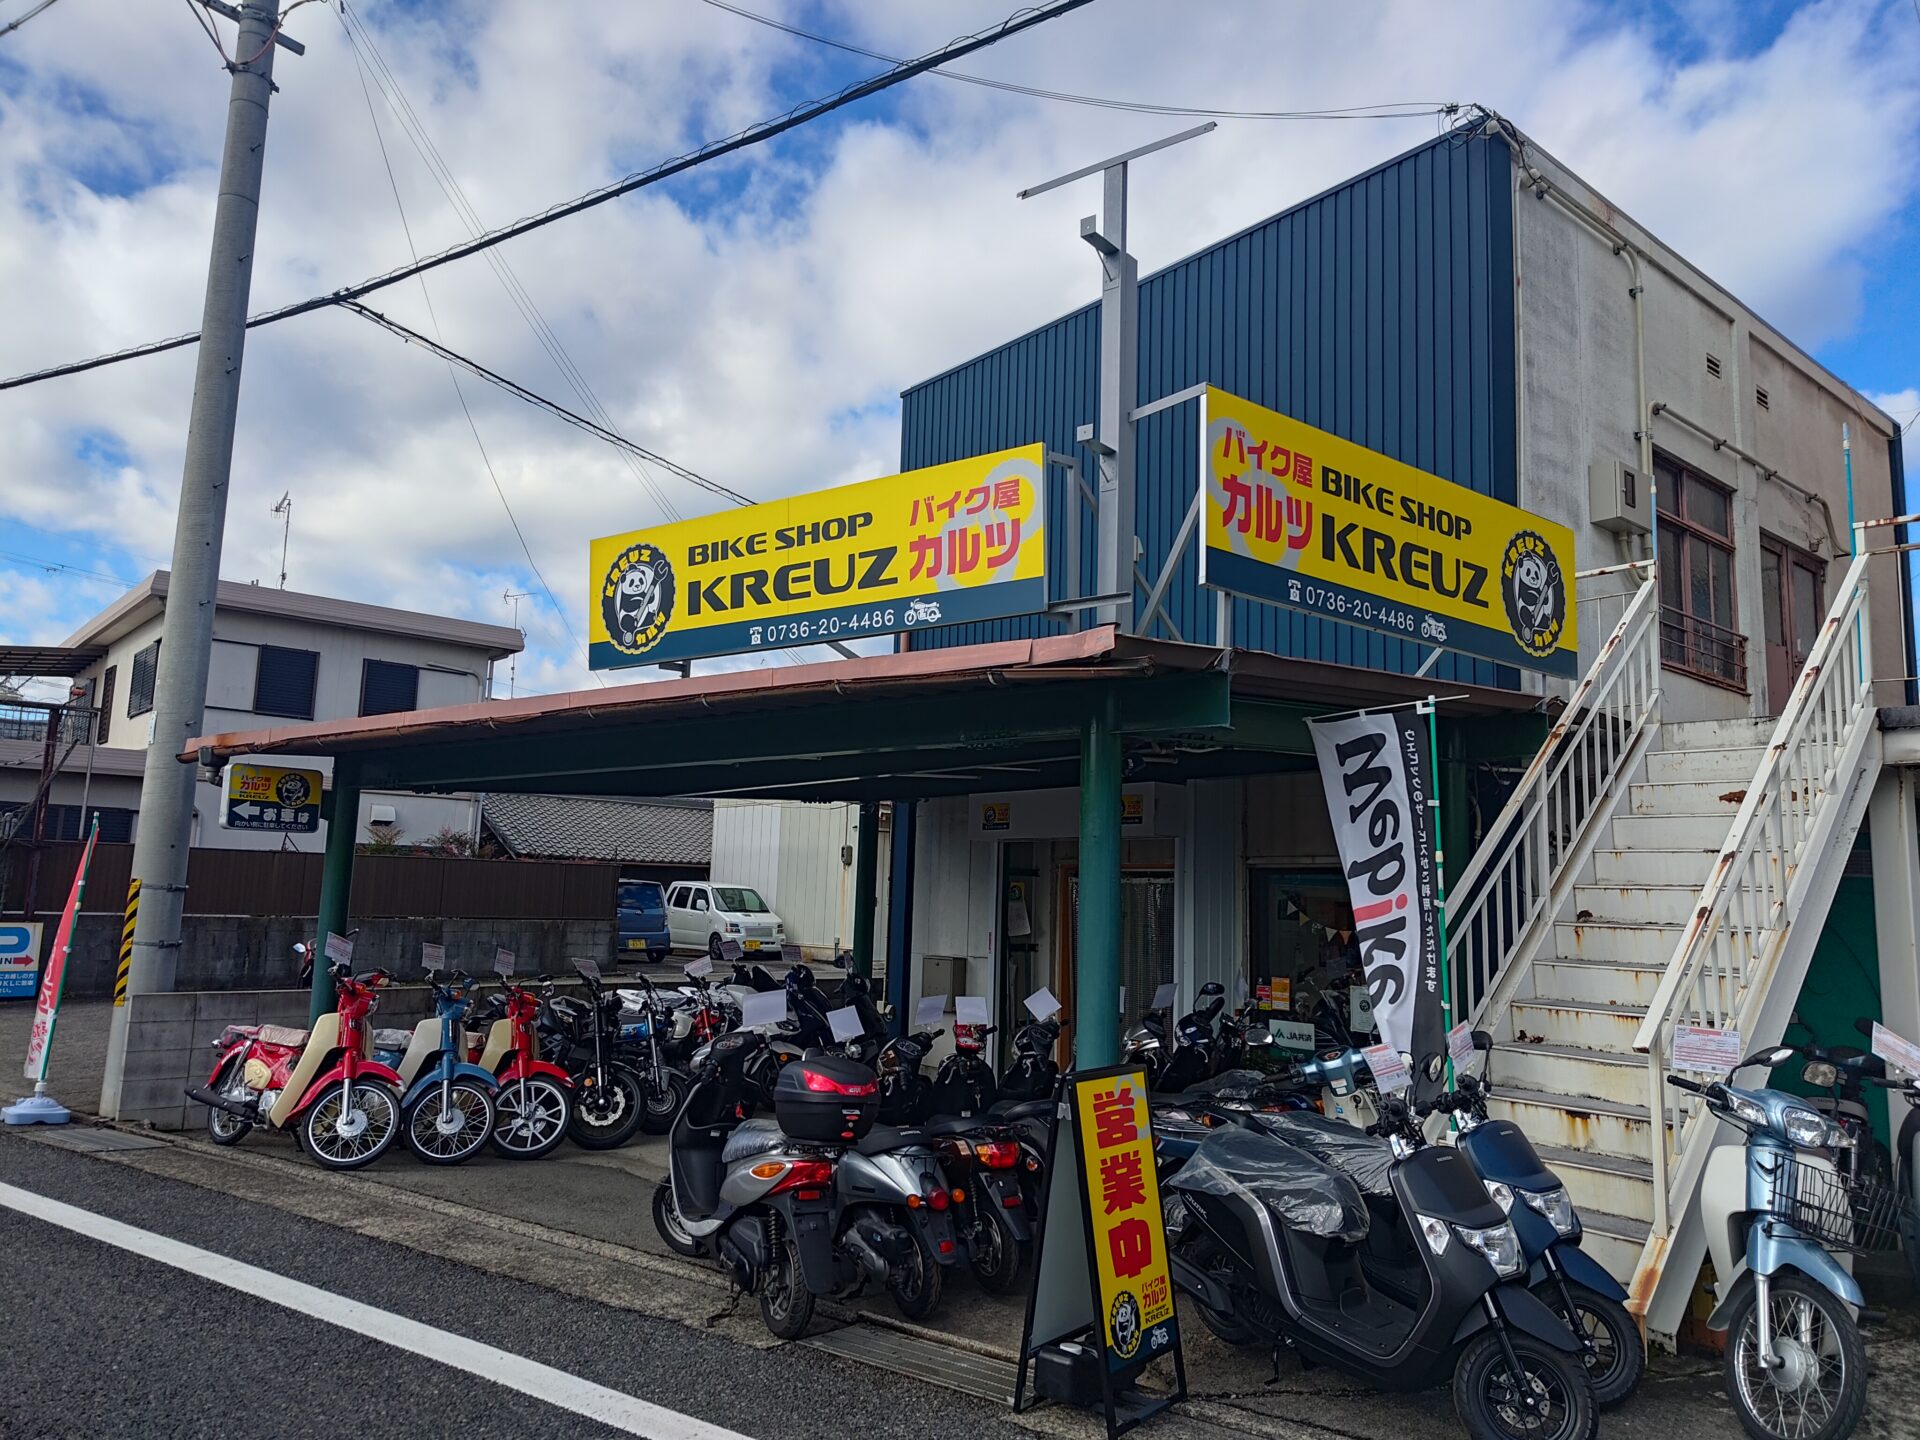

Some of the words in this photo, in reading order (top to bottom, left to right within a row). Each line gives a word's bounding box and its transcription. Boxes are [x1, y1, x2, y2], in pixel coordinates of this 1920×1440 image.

[1222, 427, 1313, 488] バイク屋
[909, 478, 1020, 527] バイク屋
[1222, 473, 1313, 550] カルツ
[1321, 465, 1394, 517] BIKE
[1400, 495, 1472, 541] SHOP
[687, 533, 768, 567] BIKE
[774, 511, 873, 551] SHOP
[909, 518, 1021, 582] カルツ
[1321, 513, 1489, 609] KREUZ
[1504, 536, 1545, 579] KREUZ
[605, 549, 652, 598] KREUZ
[687, 546, 898, 616] KREUZ
[767, 609, 894, 642] 0736-20-4486
[1305, 586, 1415, 633] 0736-20-4486
[240, 781, 272, 792] カルツ
[263, 808, 310, 823] お車は
[1093, 1087, 1152, 1279] 営業中
[1141, 1275, 1166, 1293] バイク屋
[1142, 1285, 1168, 1310] カルツ
[1144, 1307, 1170, 1325] KREUZ
